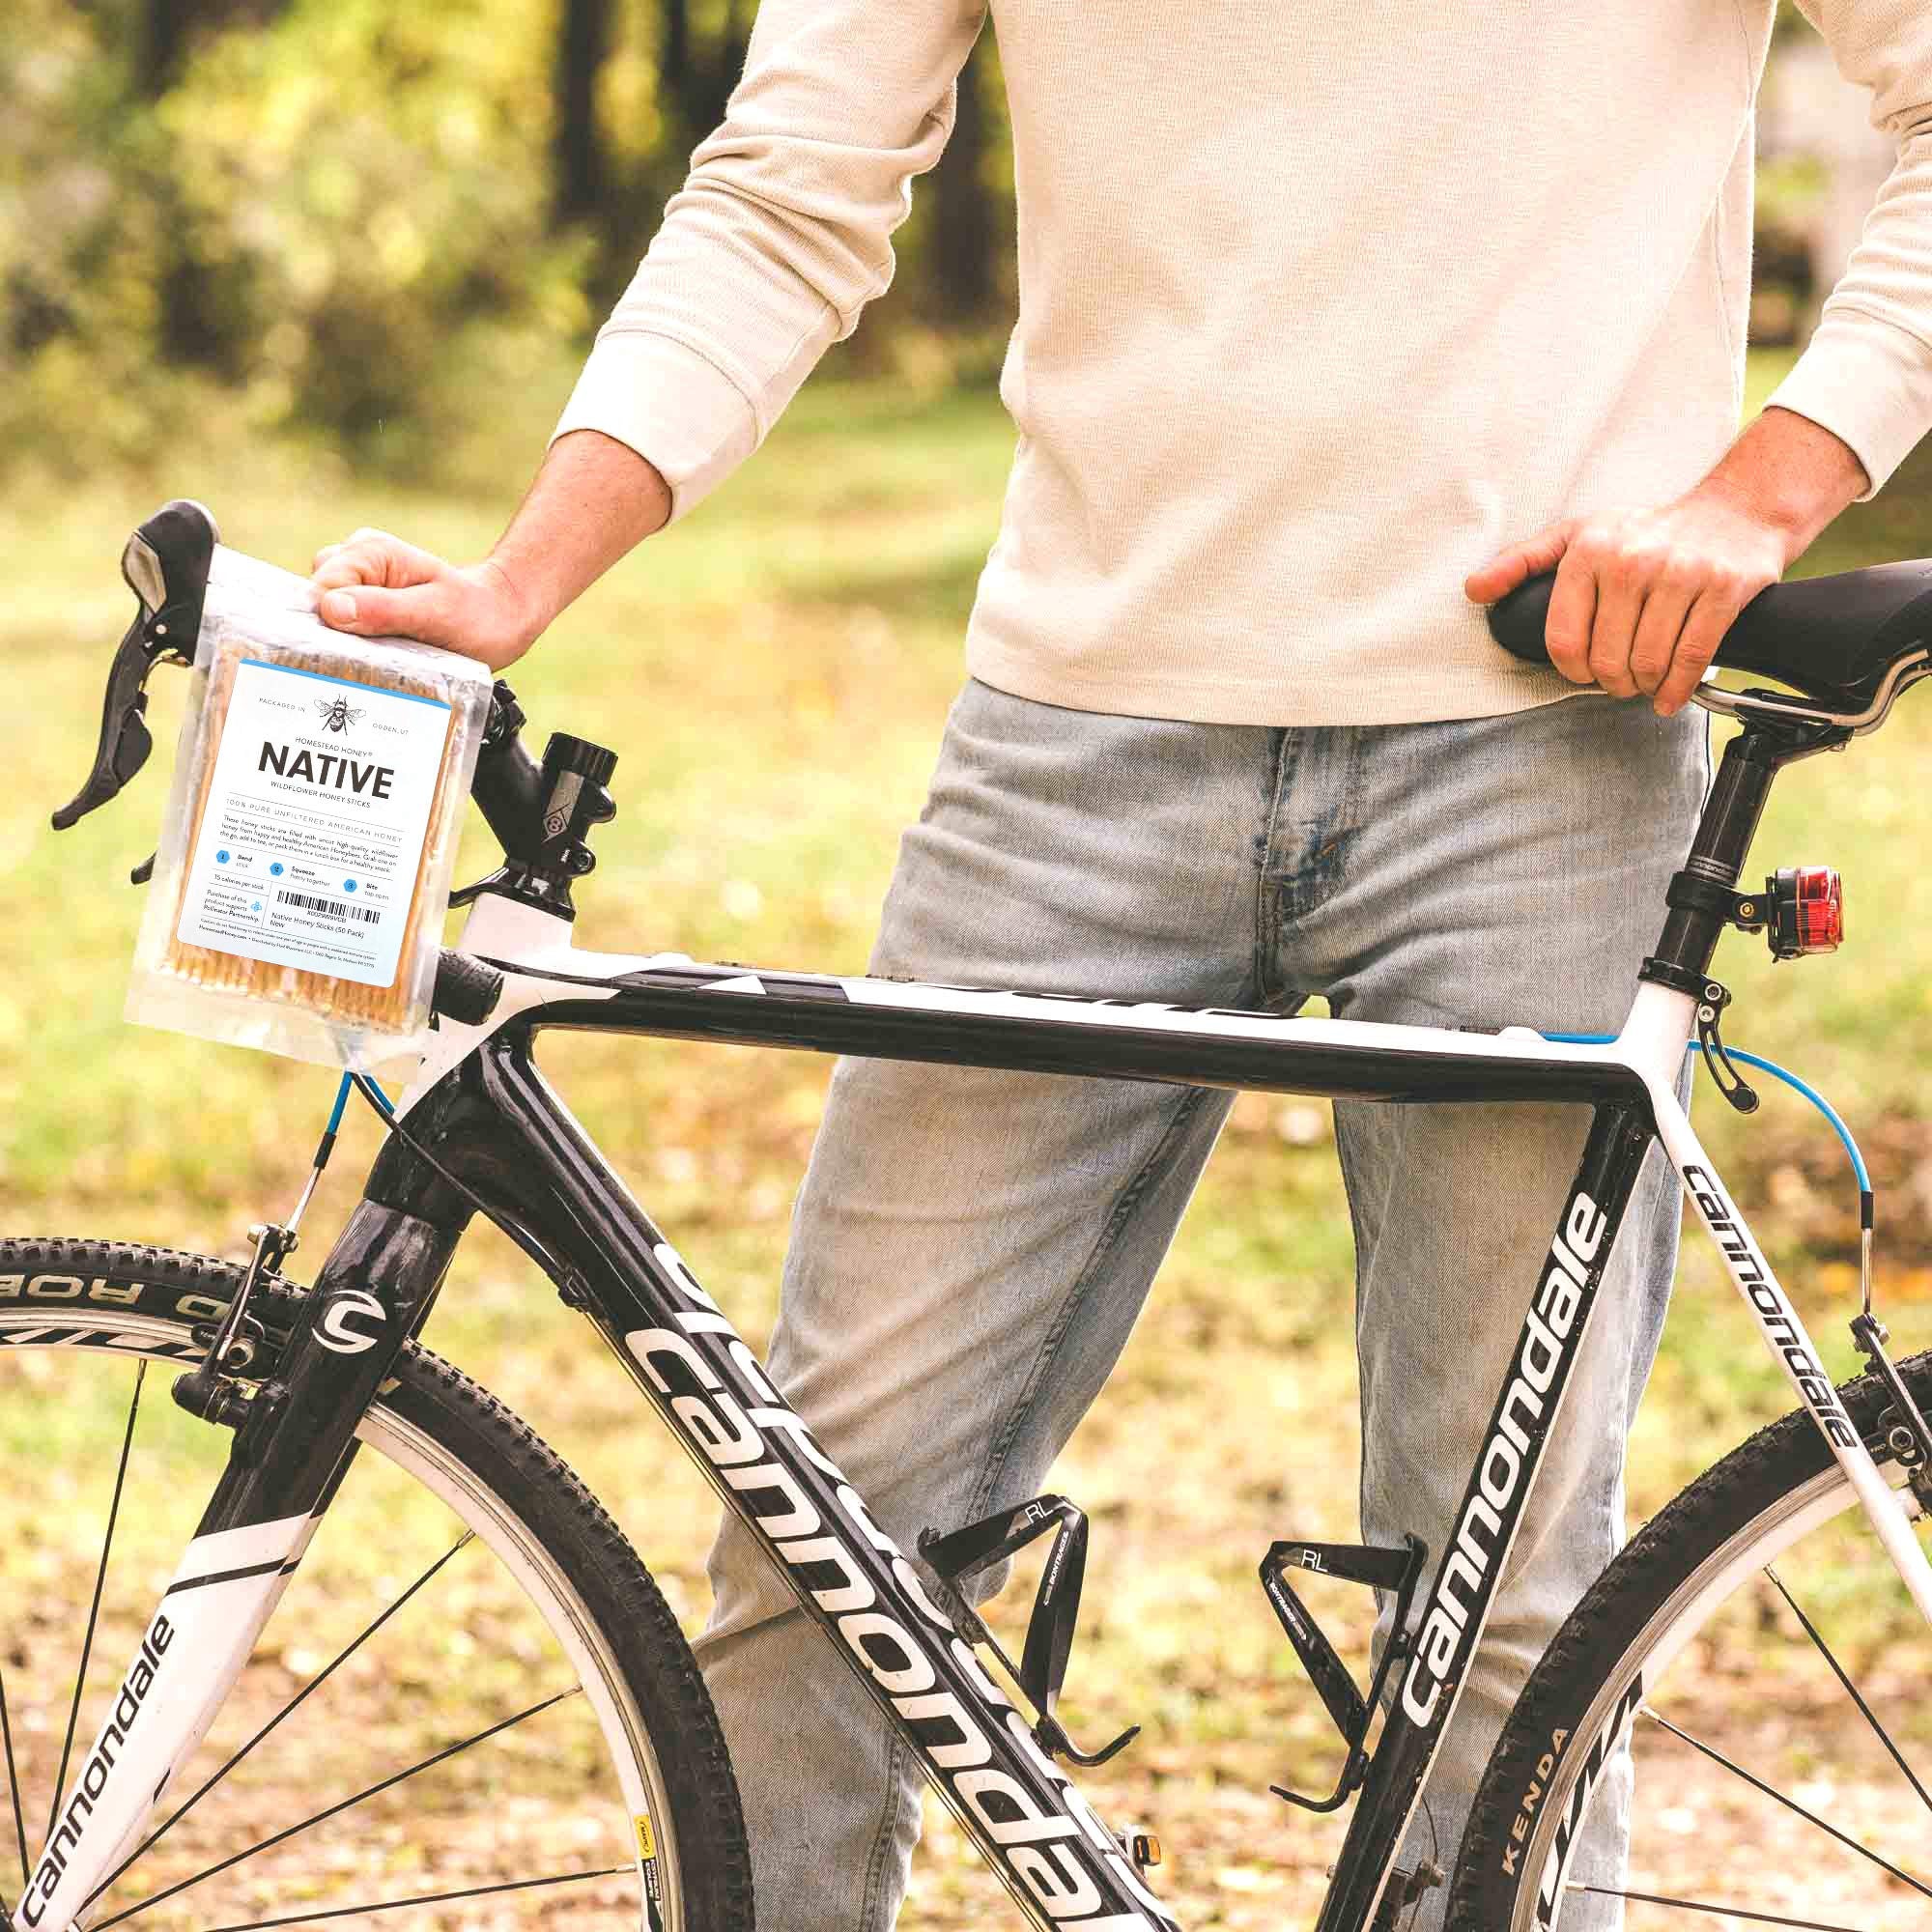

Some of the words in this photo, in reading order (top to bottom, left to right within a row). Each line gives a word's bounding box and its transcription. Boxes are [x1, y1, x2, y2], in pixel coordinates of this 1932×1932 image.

[258, 696, 296, 710] PACKAGED
[295, 736, 339, 752] HOMESTEAD
[257, 741, 395, 799] NATIVE
[270, 781, 318, 797] WILDFLOWER
[319, 791, 345, 803] HONEY
[346, 797, 371, 808] STICKS
[220, 821, 238, 832] honey
[253, 829, 270, 839] happy
[281, 836, 301, 846] healthy
[302, 840, 329, 851] American
[223, 814, 240, 823] These
[240, 818, 258, 829] honey
[260, 823, 275, 832] sticks
[335, 839, 369, 854] high-quality
[249, 803, 270, 813] PURE
[274, 809, 325, 826] UNFILTERED
[327, 821, 371, 836] AMERICAN
[373, 831, 402, 842] HONEY
[288, 844, 303, 853] them
[291, 866, 315, 877] Squeeze
[206, 889, 229, 899] Purchase
[270, 920, 285, 928] New
[270, 912, 292, 922] Native
[293, 917, 314, 927] Honey
[315, 922, 334, 931] Sticks
[346, 928, 364, 938] Pack)
[1681, 1164, 1859, 1449] cannondale
[1401, 1191, 1608, 1727] cannondale
[1024, 1500, 1055, 1524] RL
[1050, 1531, 1069, 1585] BONTRAGER
[1301, 1548, 1328, 1573] RL
[22, 1615, 175, 1927] cannondale
[1501, 1728, 1570, 1876] KENDA
